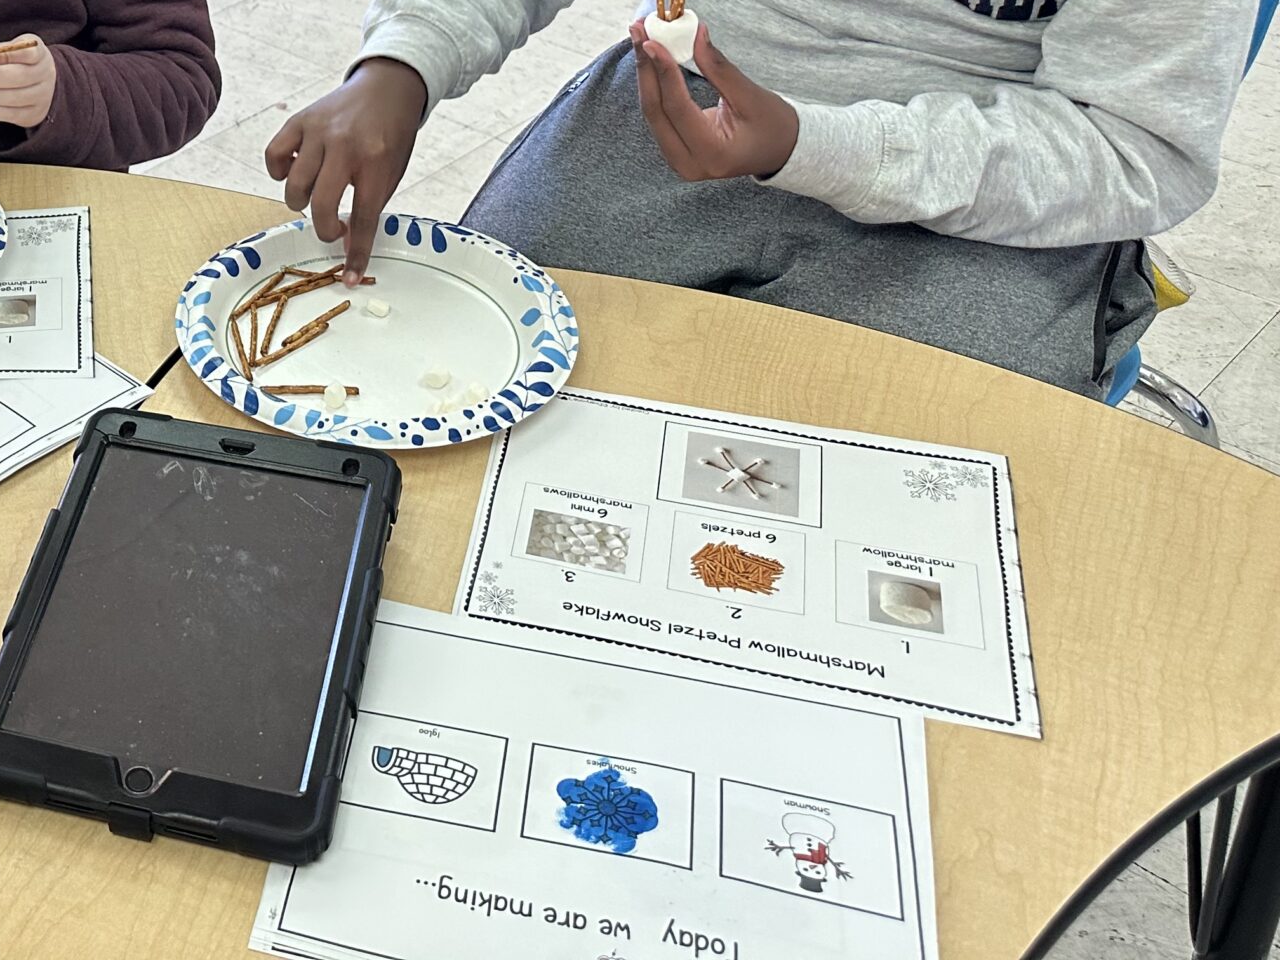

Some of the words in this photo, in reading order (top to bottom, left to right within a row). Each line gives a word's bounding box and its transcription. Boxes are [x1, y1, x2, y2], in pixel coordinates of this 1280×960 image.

[543, 487, 633, 510] marshmallows
[570, 502, 595, 513] mini
[598, 509, 608, 519] 6
[701, 522, 761, 539] pretzels
[766, 533, 777, 544] 6
[862, 547, 955, 568] marshmallow
[888, 560, 922, 574] large
[928, 566, 934, 577] 1
[561, 569, 577, 583] 3.
[562, 601, 662, 632] Snowflake
[726, 605, 743, 620] 2.
[669, 623, 741, 649] Pretzel
[901, 640, 911, 654] 1.
[749, 640, 885, 678] Marshmallow
[419, 728, 440, 739] Igloo
[784, 799, 831, 816] Snowman
[416, 875, 533, 917] making...
[543, 907, 587, 930] are
[599, 919, 631, 940] we
